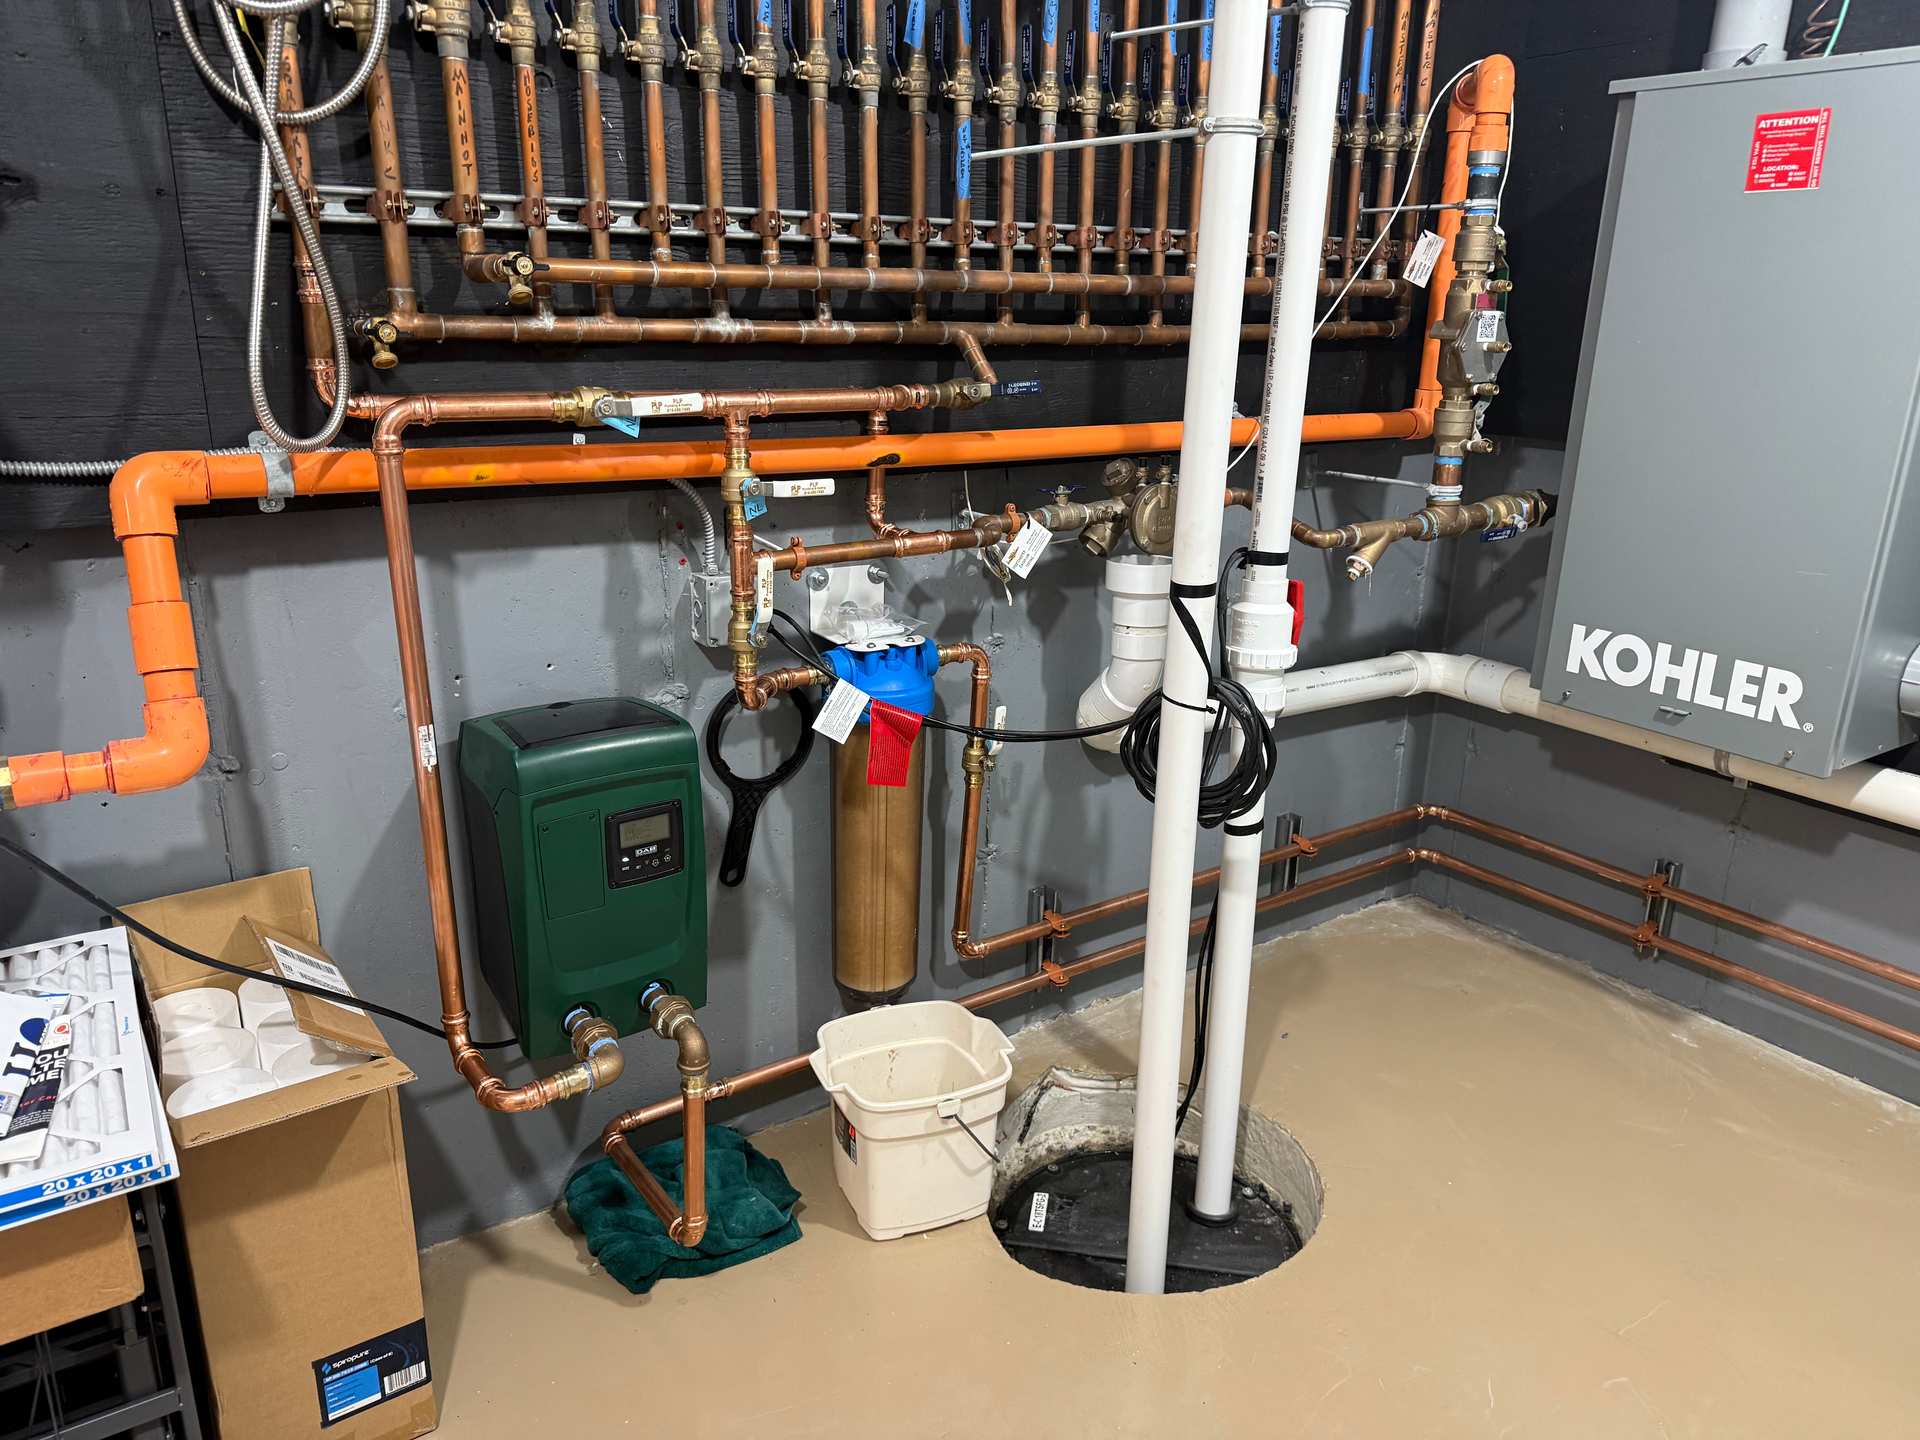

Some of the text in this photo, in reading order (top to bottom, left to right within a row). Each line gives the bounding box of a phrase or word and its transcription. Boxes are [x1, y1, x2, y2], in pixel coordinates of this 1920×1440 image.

[1393, 12, 1409, 94] MASTER H
[1420, 9, 1438, 86] MASTER C
[1758, 115, 1819, 128] ATTENTION
[1285, 161, 1293, 189] PVC1120
[1763, 164, 1799, 172] LOCATION:
[749, 504, 763, 515] NL
[41, 1156, 147, 1196] 20 x 20 x 1
[63, 1166, 167, 1207] 20 x 20 x 1
[332, 1350, 370, 1369] spiropure
